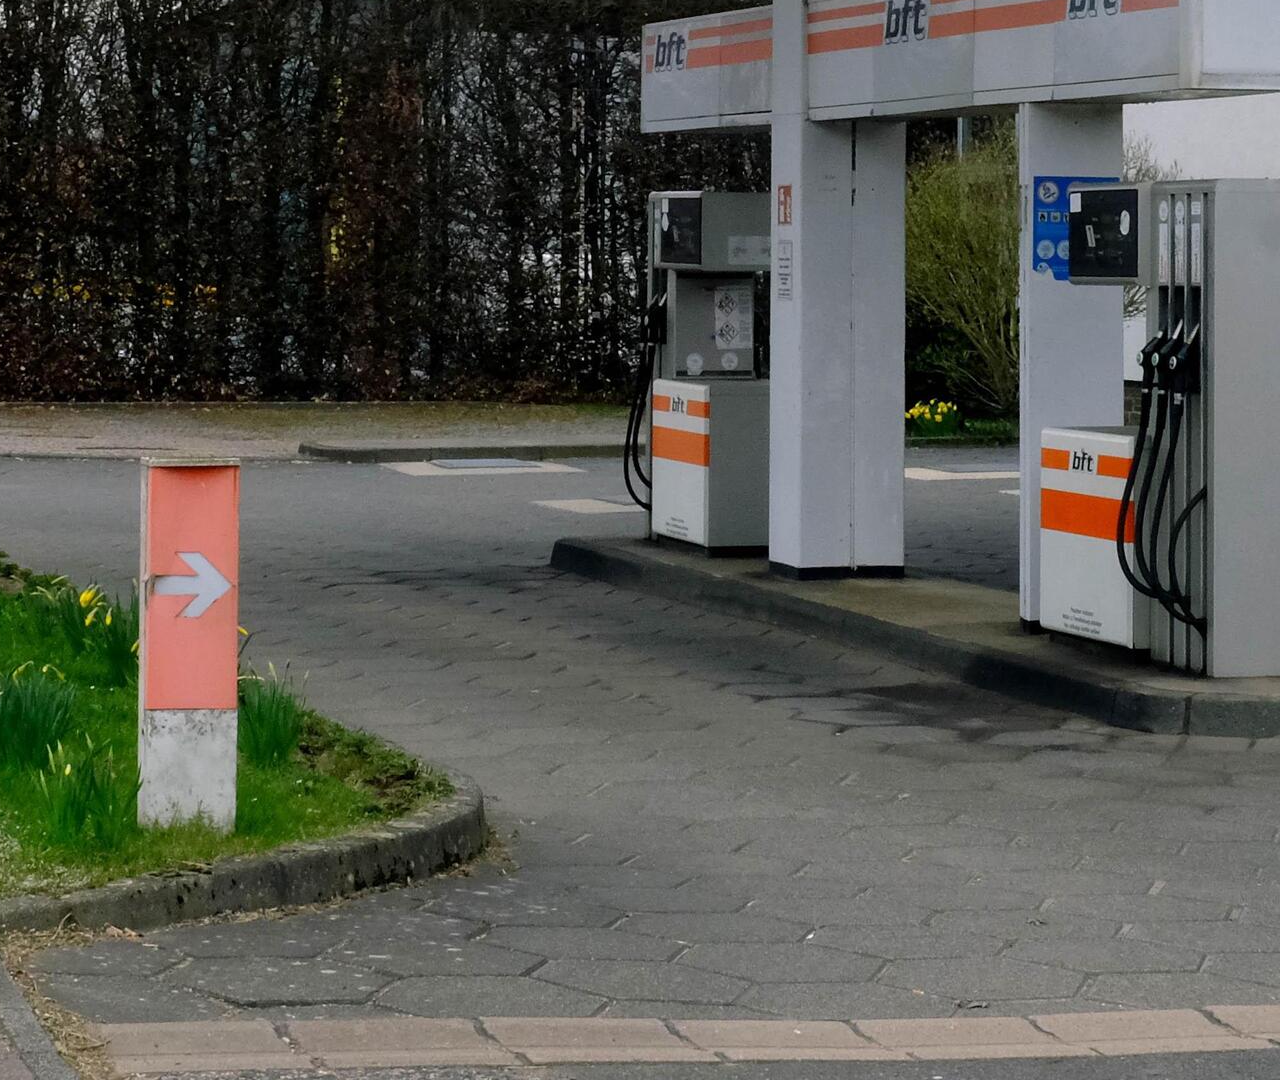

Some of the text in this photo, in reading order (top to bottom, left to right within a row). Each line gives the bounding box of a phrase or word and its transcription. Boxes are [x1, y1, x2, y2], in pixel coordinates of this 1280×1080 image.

[654, 31, 687, 72] bft
[672, 395, 685, 414] bft
[1072, 450, 1094, 472] bft
